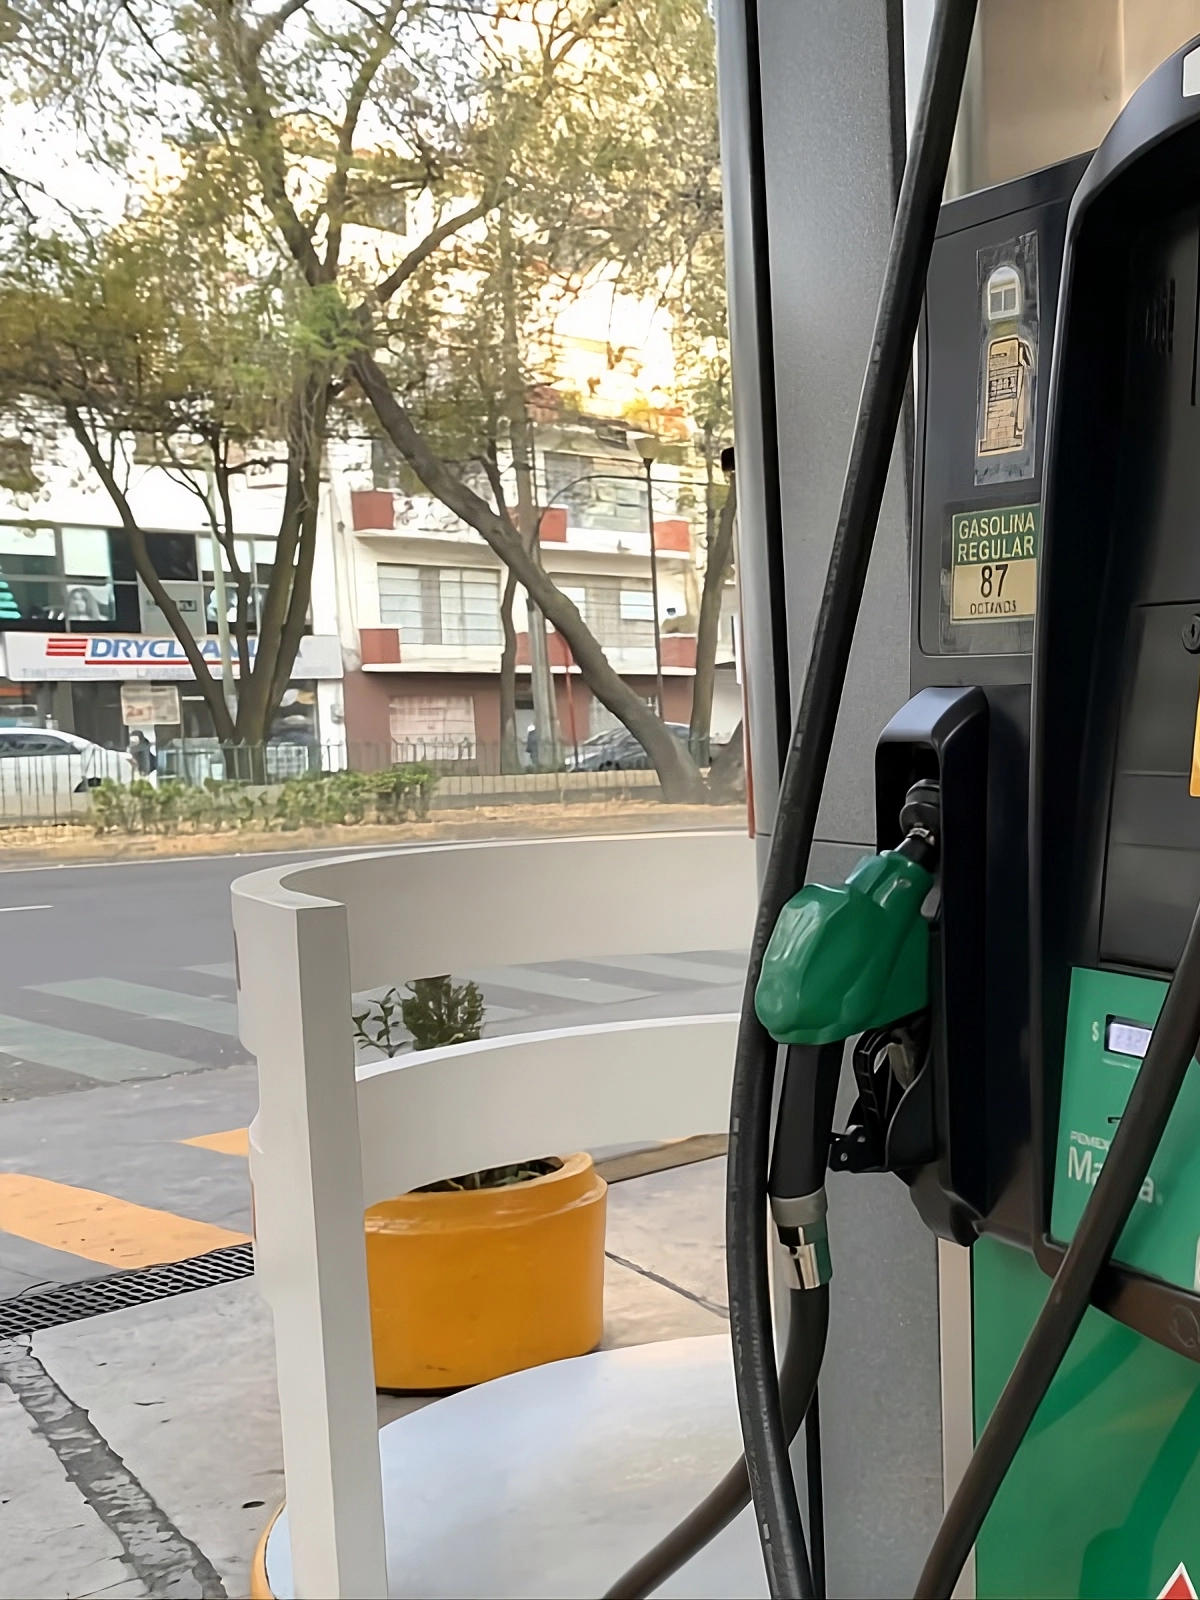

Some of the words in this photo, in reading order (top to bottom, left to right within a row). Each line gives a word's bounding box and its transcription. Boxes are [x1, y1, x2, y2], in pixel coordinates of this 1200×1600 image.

[959, 512, 1034, 539] GASOLINA
[958, 535, 1034, 562] REGULAR
[980, 564, 1009, 598] 87
